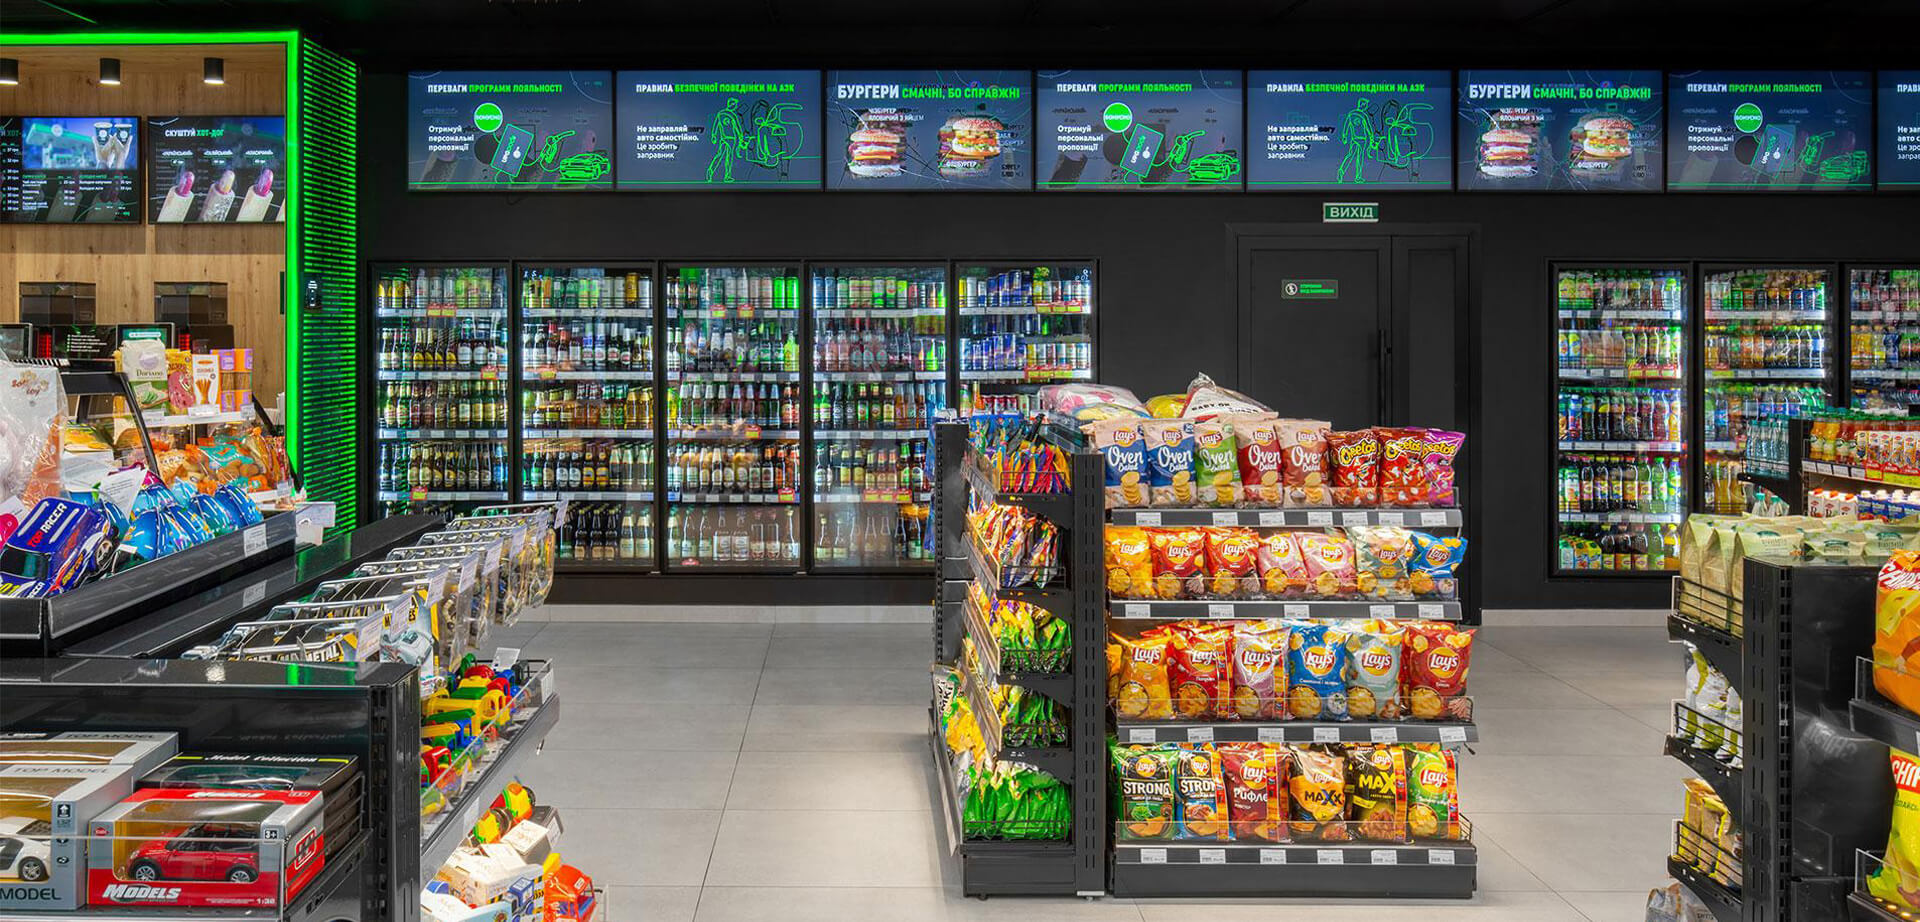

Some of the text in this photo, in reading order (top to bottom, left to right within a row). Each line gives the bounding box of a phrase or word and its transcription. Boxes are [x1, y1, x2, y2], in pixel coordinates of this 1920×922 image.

[428, 84, 562, 93] ПЕРЕВАГИ ПРОГРАМИ ЛОЯЛЬНОСТІ
[636, 82, 794, 94] ПРАВИЛА БЕЗПЕЧНОЇ ПОВЕДІНКИ НА АЗК
[838, 84, 1020, 100] БУРГЕРИ СМАЧНІ, БО СПРАВЖНІ
[1057, 84, 1192, 92] ПЕРЕВАГИ ПРОГРАМИ ЛОЯЛЬНОСТІ
[1267, 82, 1424, 93] ПРАВИЛА БЕЗПЕЧНОЇ ПОВЕДІНКИ НА АЗК
[1470, 84, 1651, 100] БУРГЕРИ СМАЧНІ, БО СПРАВЖНІ
[1687, 84, 1822, 92] ПЕРЕВАГИ ПРОГРАМИ ЛОЯЛЬНОСТІ
[165, 127, 196, 137] СКУШТУЙ
[648, 125, 687, 134] заправляй
[1279, 125, 1318, 134] заправляй
[1688, 126, 1722, 134] Отримуй
[429, 134, 474, 142] персональні
[1057, 134, 1103, 142] персональні
[1688, 134, 1734, 143] персональні
[429, 143, 469, 152] пропозиції
[648, 143, 678, 151] зробить
[1057, 143, 1098, 152] пропозиції
[1279, 143, 1308, 151] зробить
[1688, 143, 1728, 152] пропозиції
[1330, 207, 1374, 218] ВИХІД
[1108, 446, 1143, 467] Oven
[1158, 446, 1193, 467] Oven
[1200, 449, 1235, 470] Oven
[1248, 445, 1282, 466] Oven
[27, 502, 68, 547] TOP RACER
[1123, 781, 1170, 795] STRONG
[265, 830, 277, 838] 3+
[0, 888, 62, 900] MODEL
